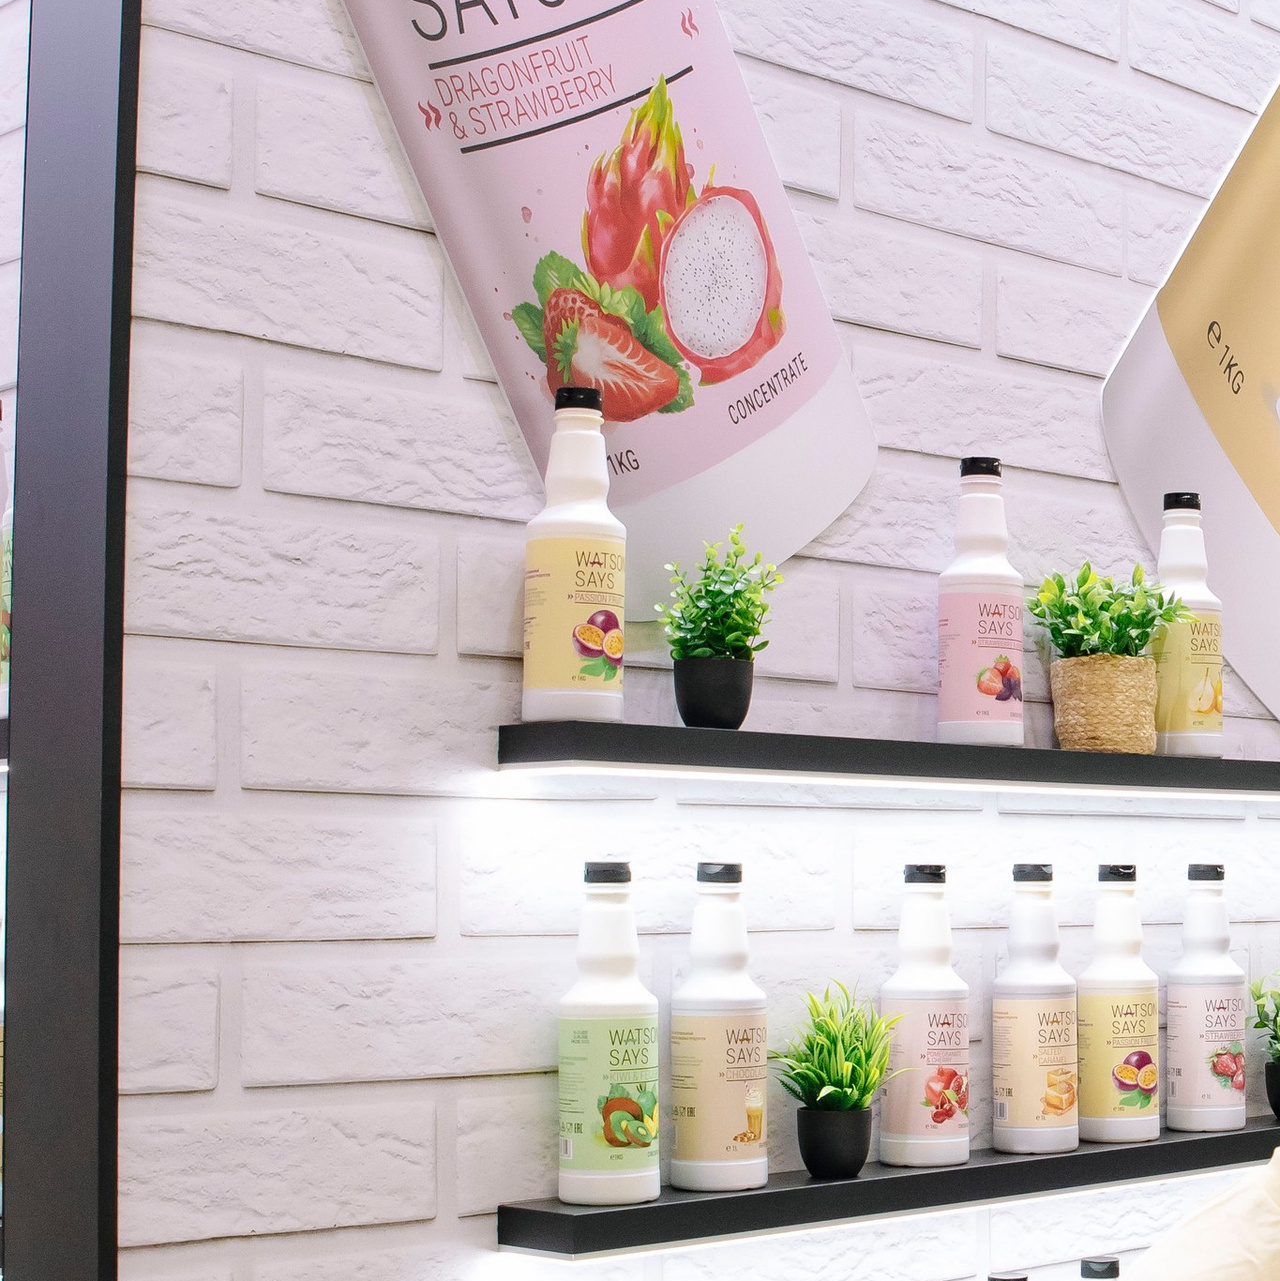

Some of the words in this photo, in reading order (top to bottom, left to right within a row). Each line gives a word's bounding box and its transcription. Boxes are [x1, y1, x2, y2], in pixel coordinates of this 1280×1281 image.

[435, 35, 595, 105] DRAGONFRUIT
[450, 113, 467, 140] &
[470, 68, 619, 135] STRAWBERRY
[1219, 344, 1245, 396] 1KG
[728, 352, 809, 425] CONCENTRATE
[575, 550, 623, 571] WATSO
[575, 570, 615, 589] SAYS
[574, 592, 608, 602] PASSION
[978, 603, 1021, 621] WATSO
[978, 620, 1013, 636] SAYS
[1190, 623, 1220, 636] WATS
[1190, 638, 1218, 652] SAYS
[1205, 998, 1242, 1012] WATSO
[927, 1013, 967, 1028] WATSO
[1038, 1011, 1075, 1026] WATSO
[1205, 1014, 1236, 1028] SAYS
[1112, 1020, 1146, 1035] SAYS
[609, 1027, 656, 1046] WATSO
[726, 1027, 766, 1045] WATSO
[927, 1031, 961, 1046] SAYS
[1038, 1028, 1070, 1043] SAYS
[1112, 1038, 1139, 1046] PASSION
[609, 1048, 649, 1066] SAYS
[726, 1047, 760, 1064] SAYS
[1039, 1048, 1062, 1056] SALTED
[1039, 1056, 1067, 1064] CARAMEL
[610, 1072, 633, 1081] KIWI
